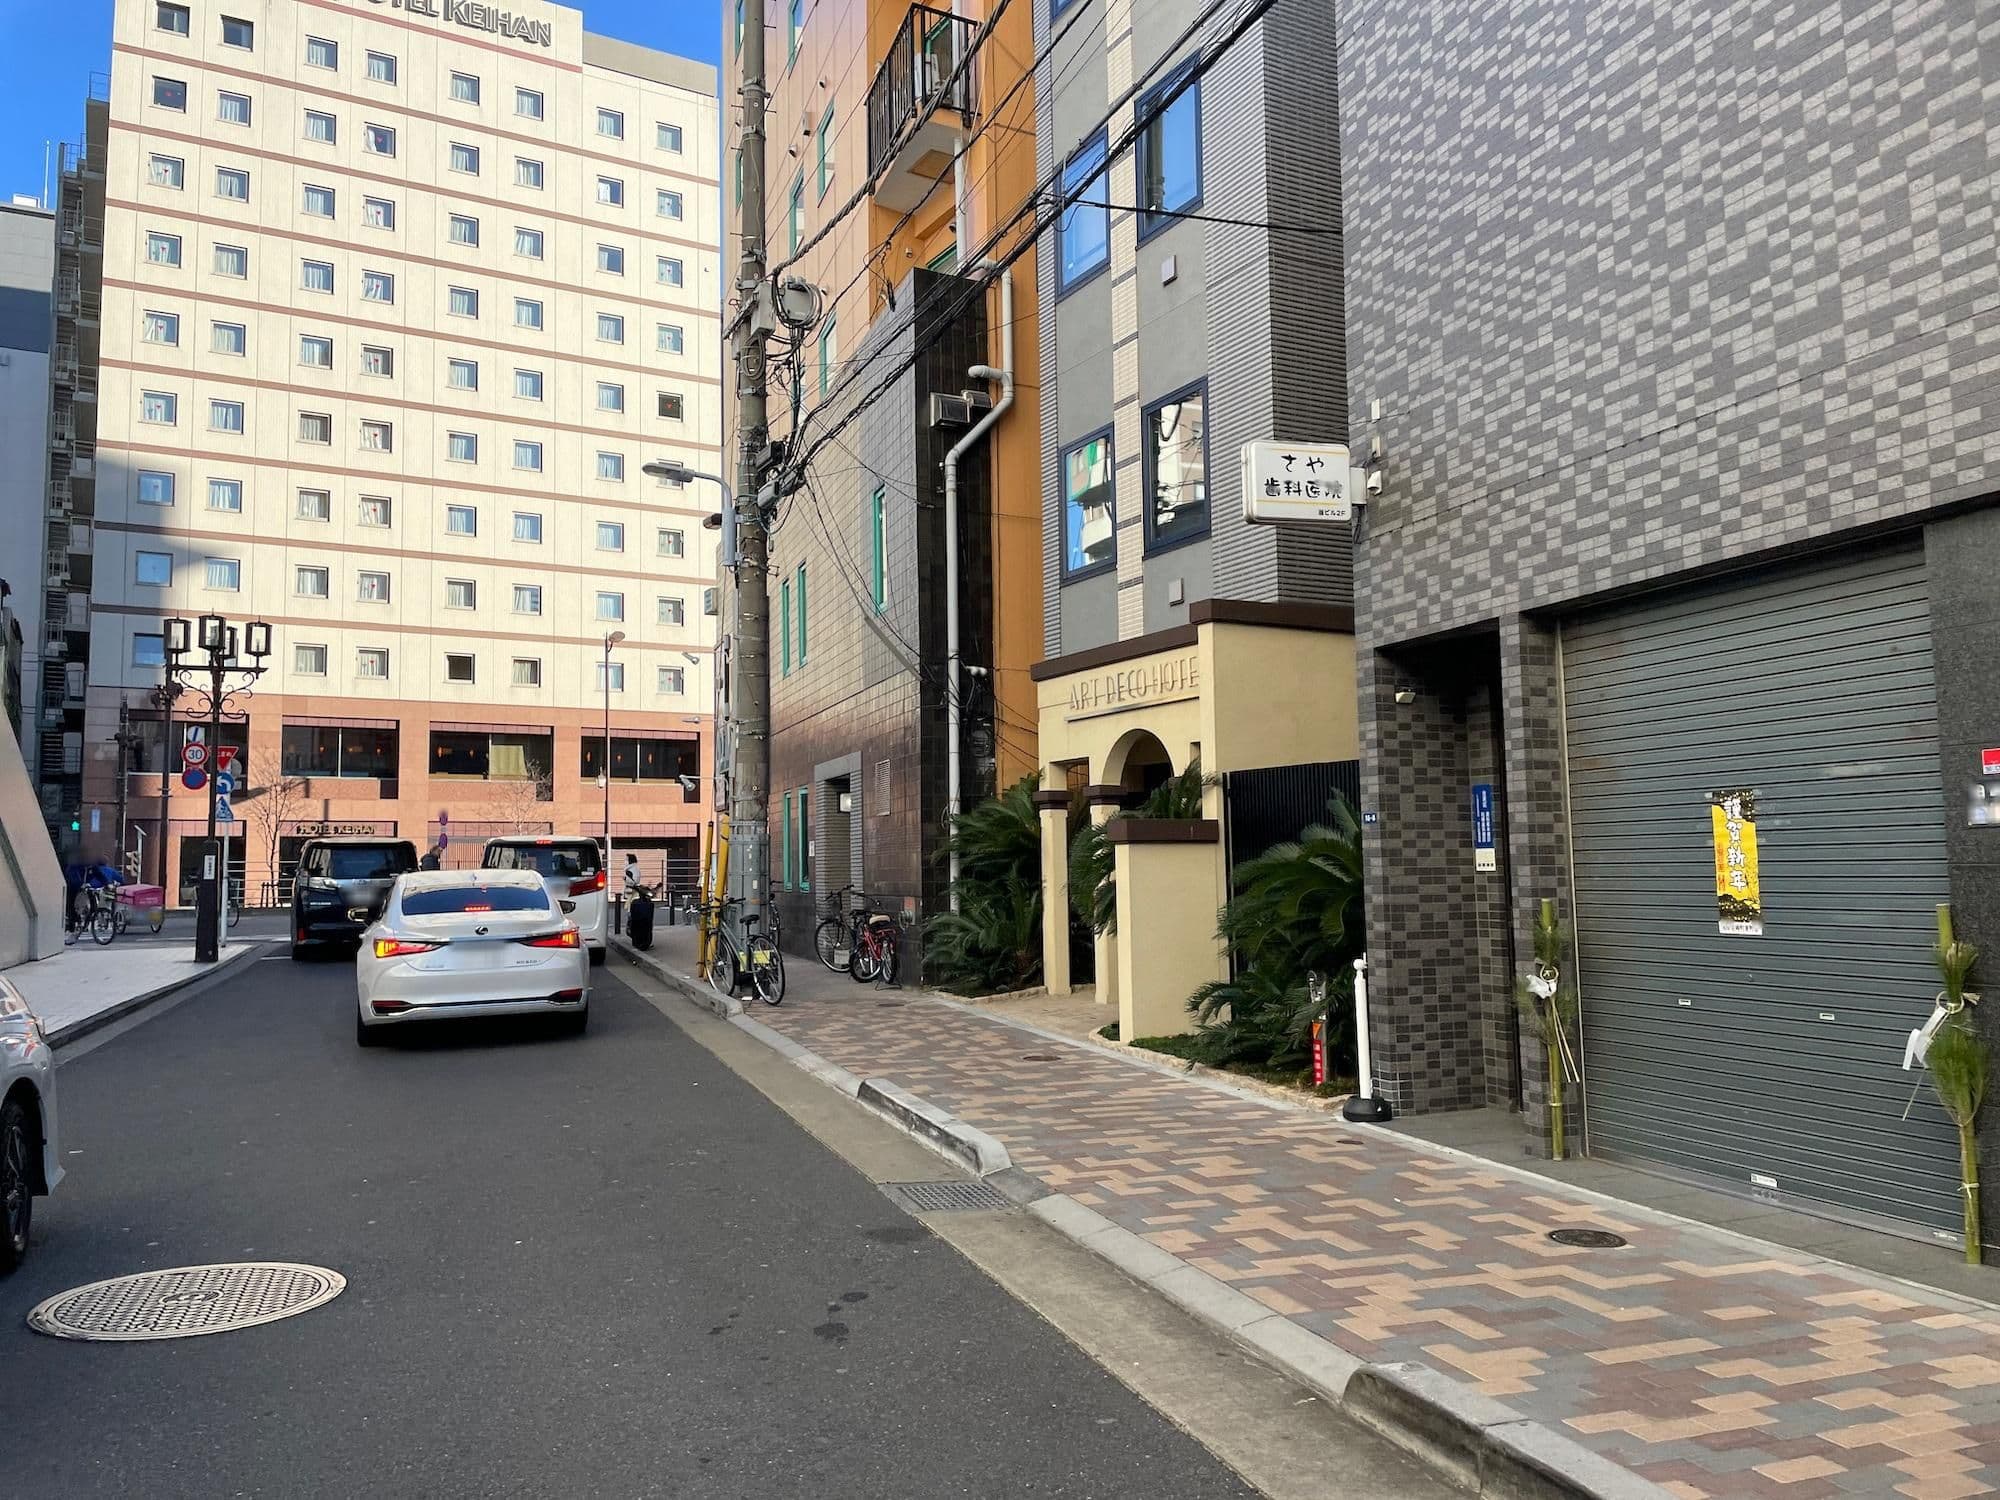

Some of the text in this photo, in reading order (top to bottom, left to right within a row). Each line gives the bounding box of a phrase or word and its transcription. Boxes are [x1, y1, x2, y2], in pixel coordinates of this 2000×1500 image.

[443, 0, 552, 47] KEIHAN
[1280, 454, 1325, 473] さや
[1070, 656, 1199, 710] ART DECO HOTE
[188, 749, 203, 760] 30
[1723, 797, 1747, 892] 謹賀新年
